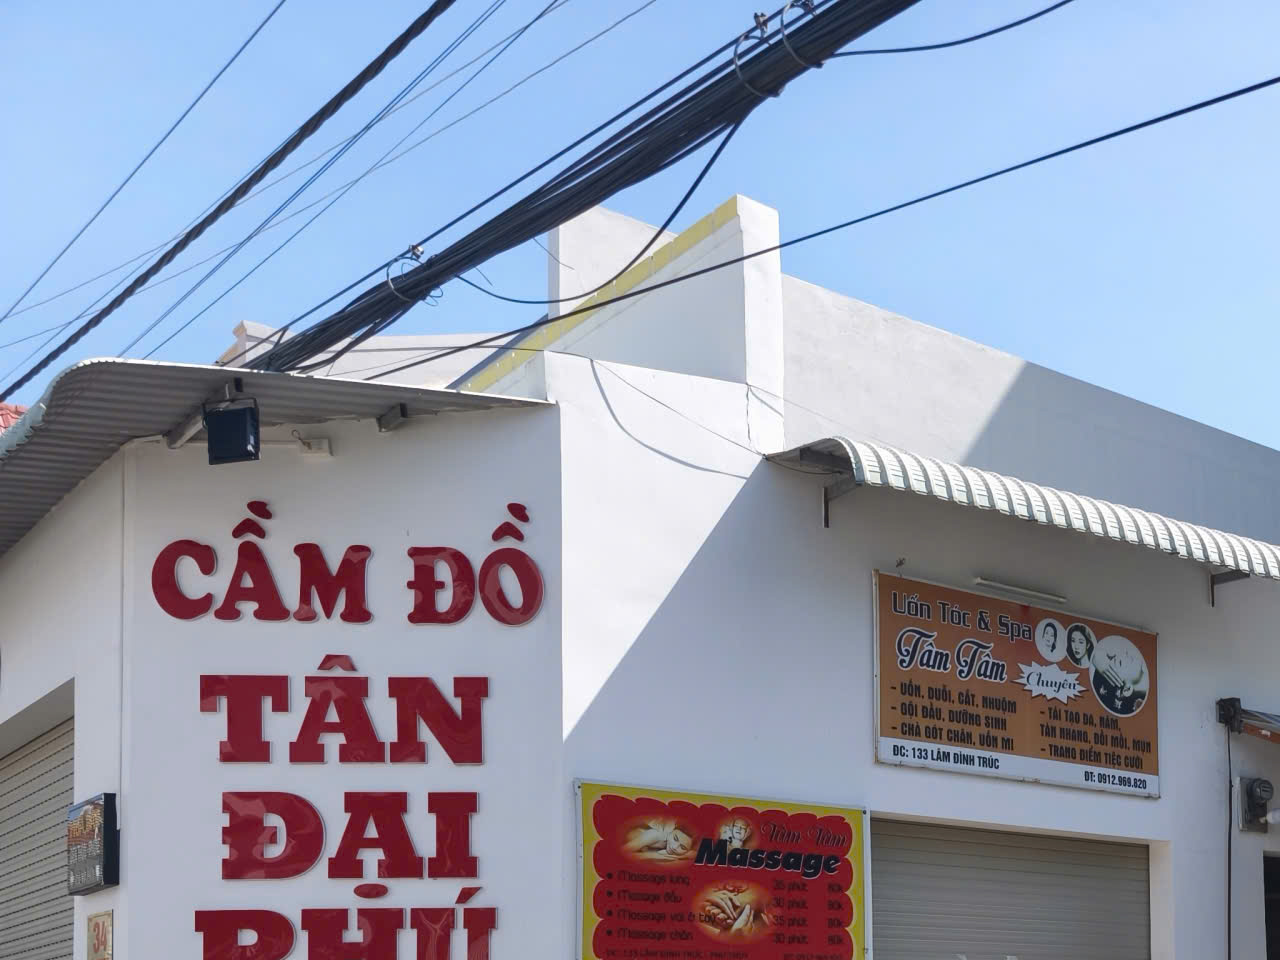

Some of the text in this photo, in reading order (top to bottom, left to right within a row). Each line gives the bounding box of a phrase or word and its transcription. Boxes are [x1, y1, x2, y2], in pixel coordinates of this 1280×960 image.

[151, 500, 546, 627] CẦM ĐỒ
[892, 591, 1033, 643] Uốn Tóc & Spa
[896, 627, 1007, 684] Tâm Tâm
[1026, 670, 1080, 699] Chuyên
[199, 654, 490, 766] TÂN
[984, 715, 1007, 731] SINH
[892, 744, 1000, 770] ĐC: 133 LÂM ĐÌNH TRÚC
[1084, 771, 1096, 783] ĐT:
[221, 791, 480, 900] ĐẠI
[694, 837, 842, 880] Massage
[92, 920, 108, 954] 34
